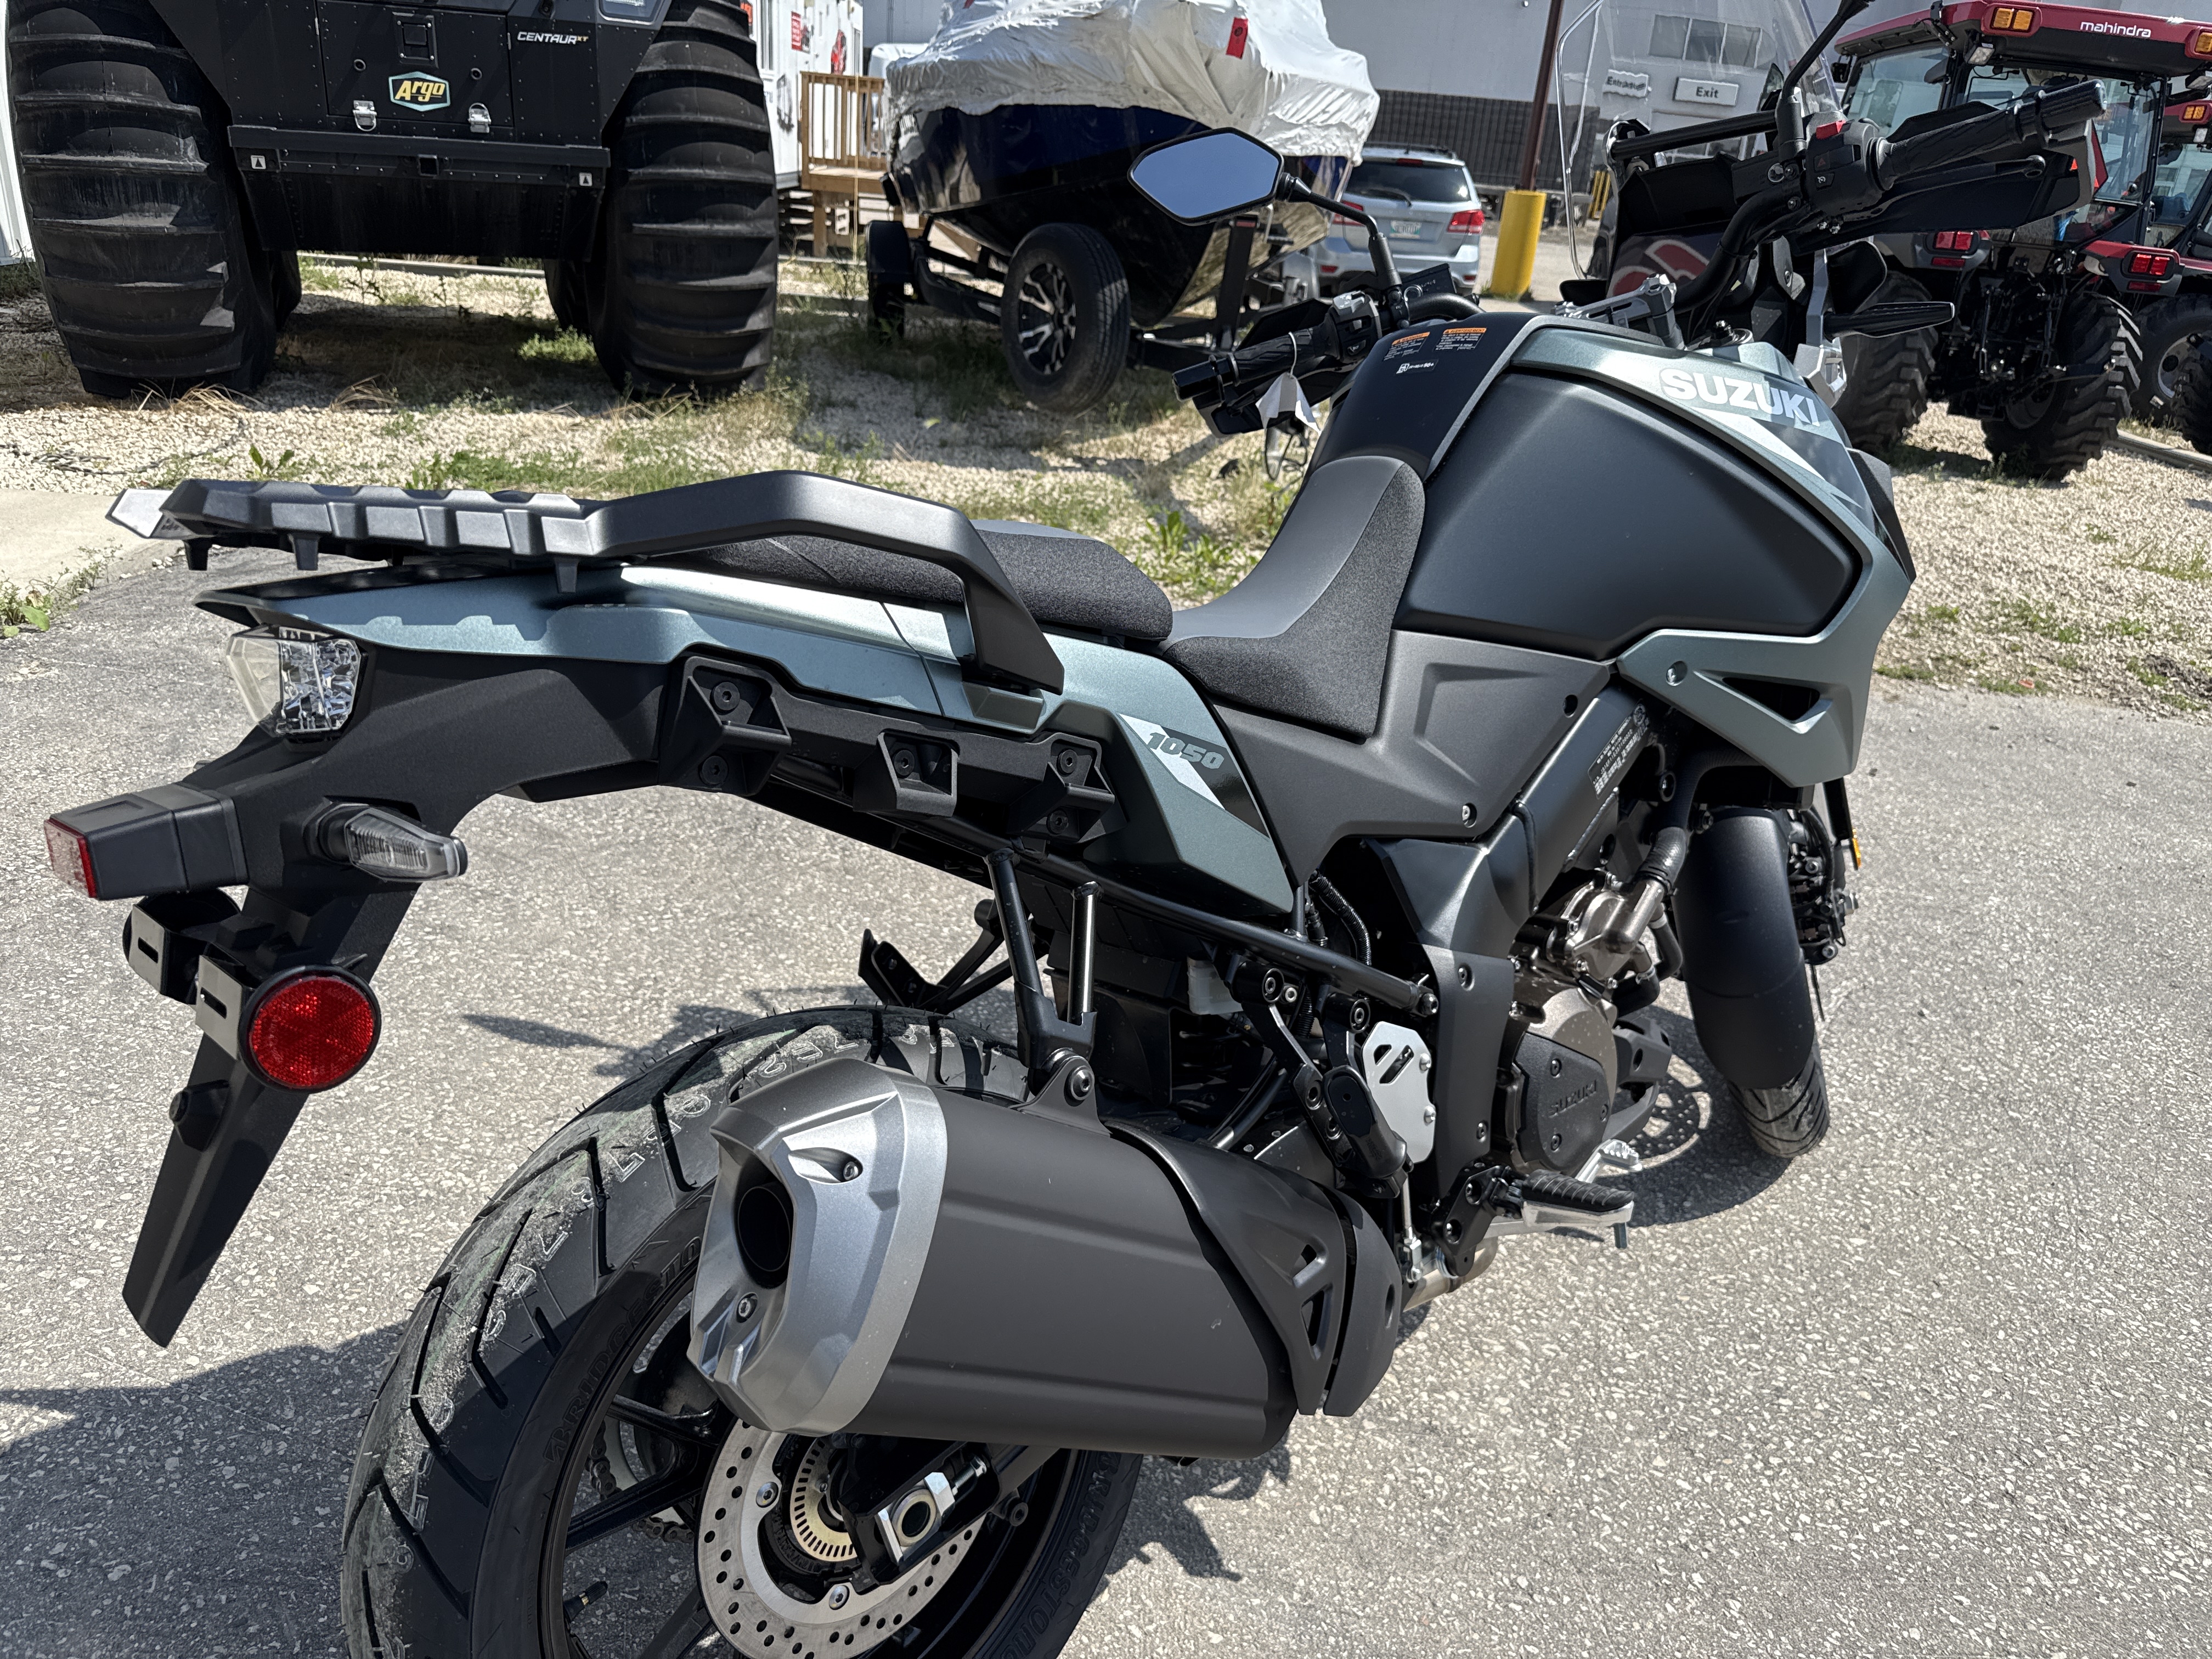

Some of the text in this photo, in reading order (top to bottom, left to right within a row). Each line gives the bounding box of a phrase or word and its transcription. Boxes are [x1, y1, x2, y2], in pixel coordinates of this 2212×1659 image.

[2080, 21, 2152, 38] mahindra
[394, 80, 445, 102] Argo
[1695, 86, 1719, 99] Exit
[1659, 368, 1820, 427] SUZUKI
[1147, 732, 1225, 769] 1050
[1549, 1079, 1597, 1118] SUZUKI
